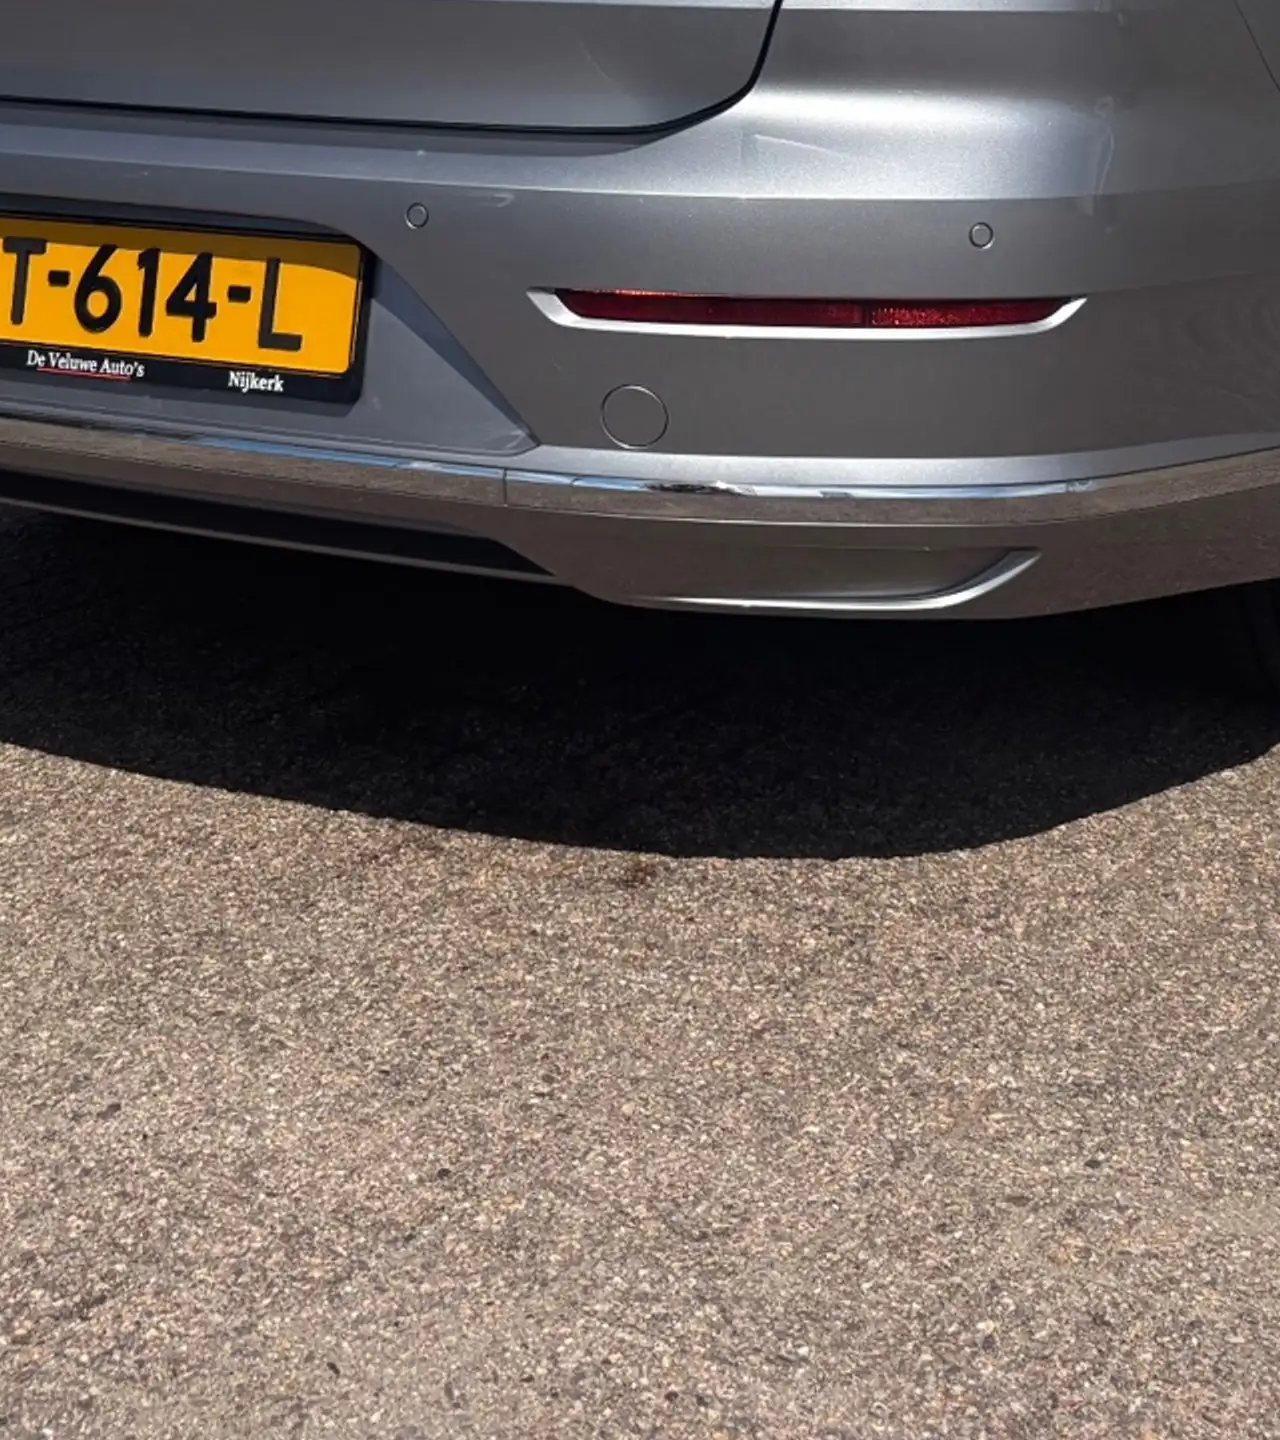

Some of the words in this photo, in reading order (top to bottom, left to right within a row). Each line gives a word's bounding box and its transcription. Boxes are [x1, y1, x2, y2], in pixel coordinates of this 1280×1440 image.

[26, 350, 46, 367] De
[47, 352, 98, 373] Veluwe
[99, 357, 146, 377] Auto's
[227, 370, 284, 393] Nijkerk
